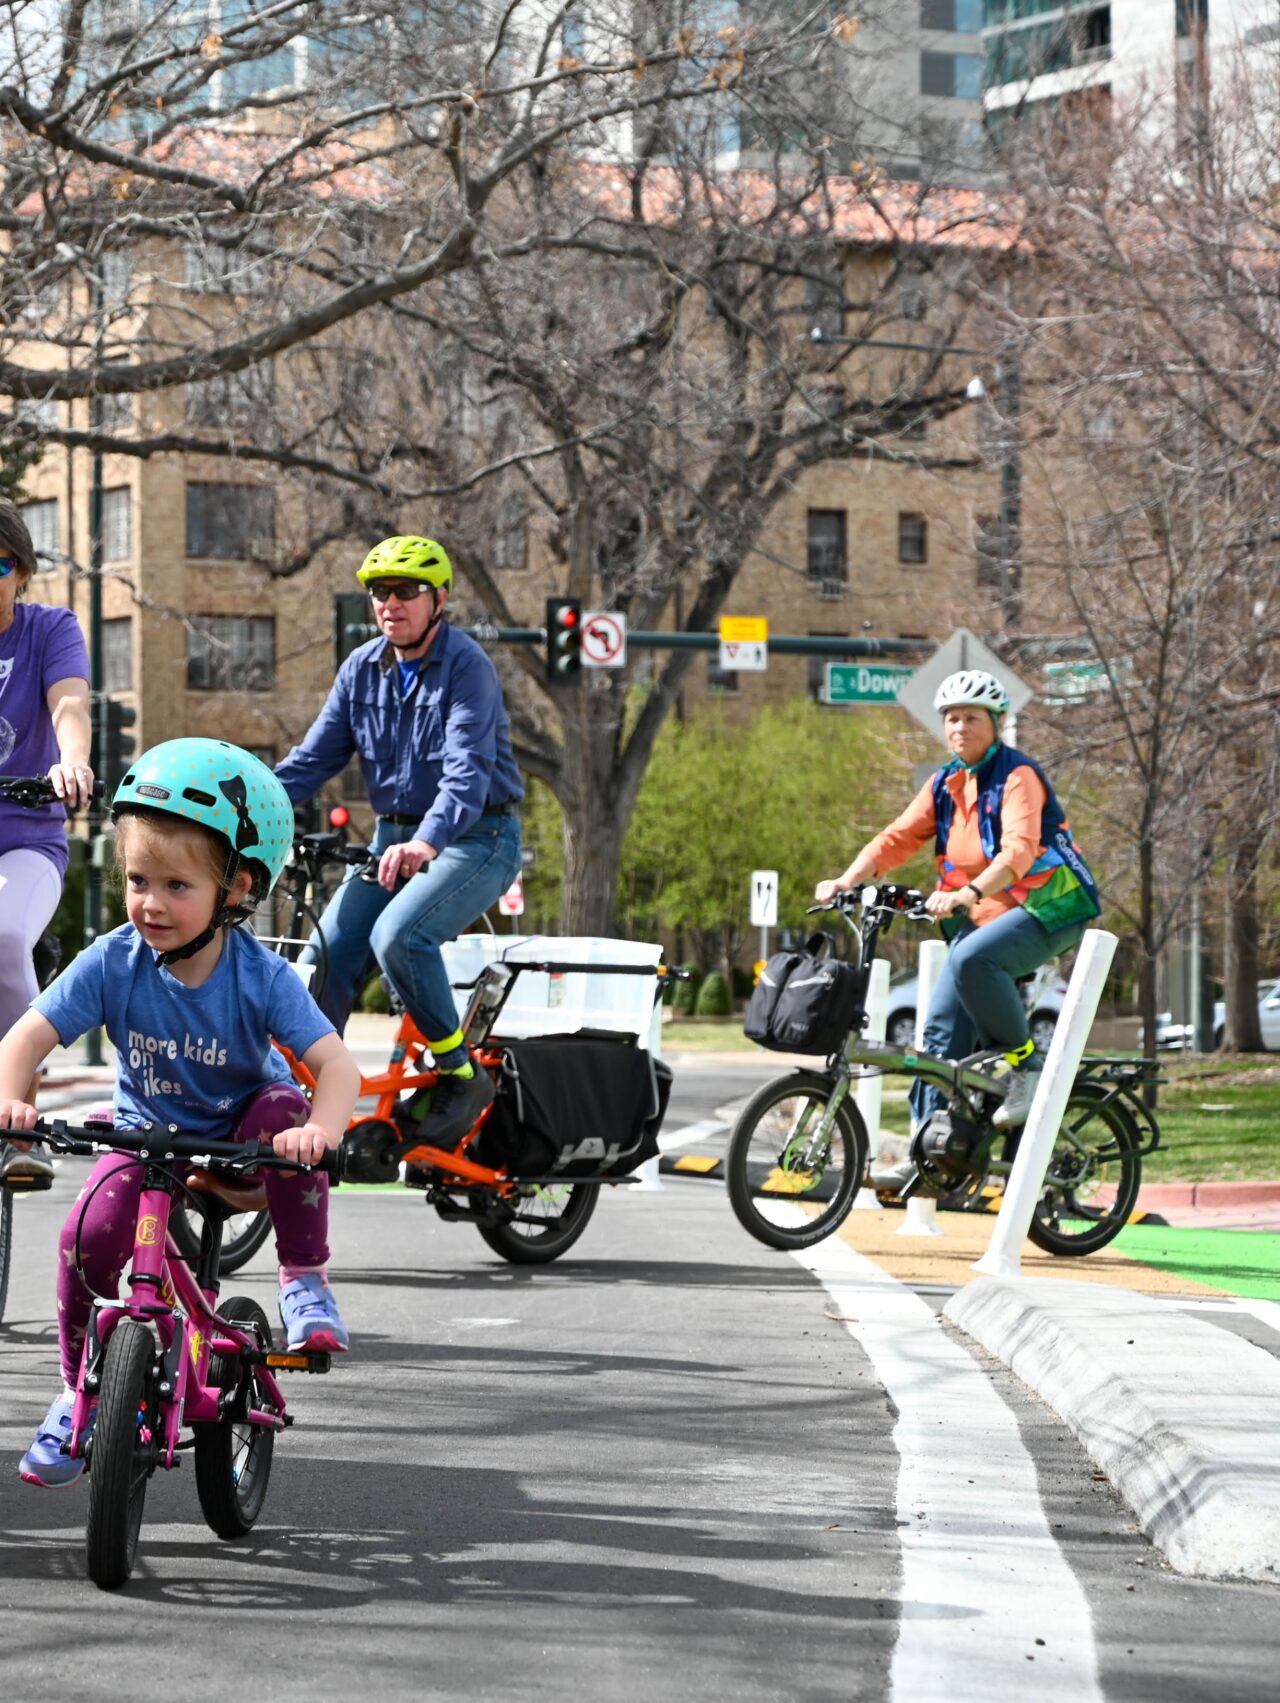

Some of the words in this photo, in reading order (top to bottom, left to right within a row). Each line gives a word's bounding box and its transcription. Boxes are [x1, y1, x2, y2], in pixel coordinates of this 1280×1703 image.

[857, 667, 904, 693] Dow
[128, 1030, 177, 1060] more
[184, 1032, 227, 1066] kids
[129, 1048, 154, 1069] on
[140, 1067, 183, 1097] ikes
